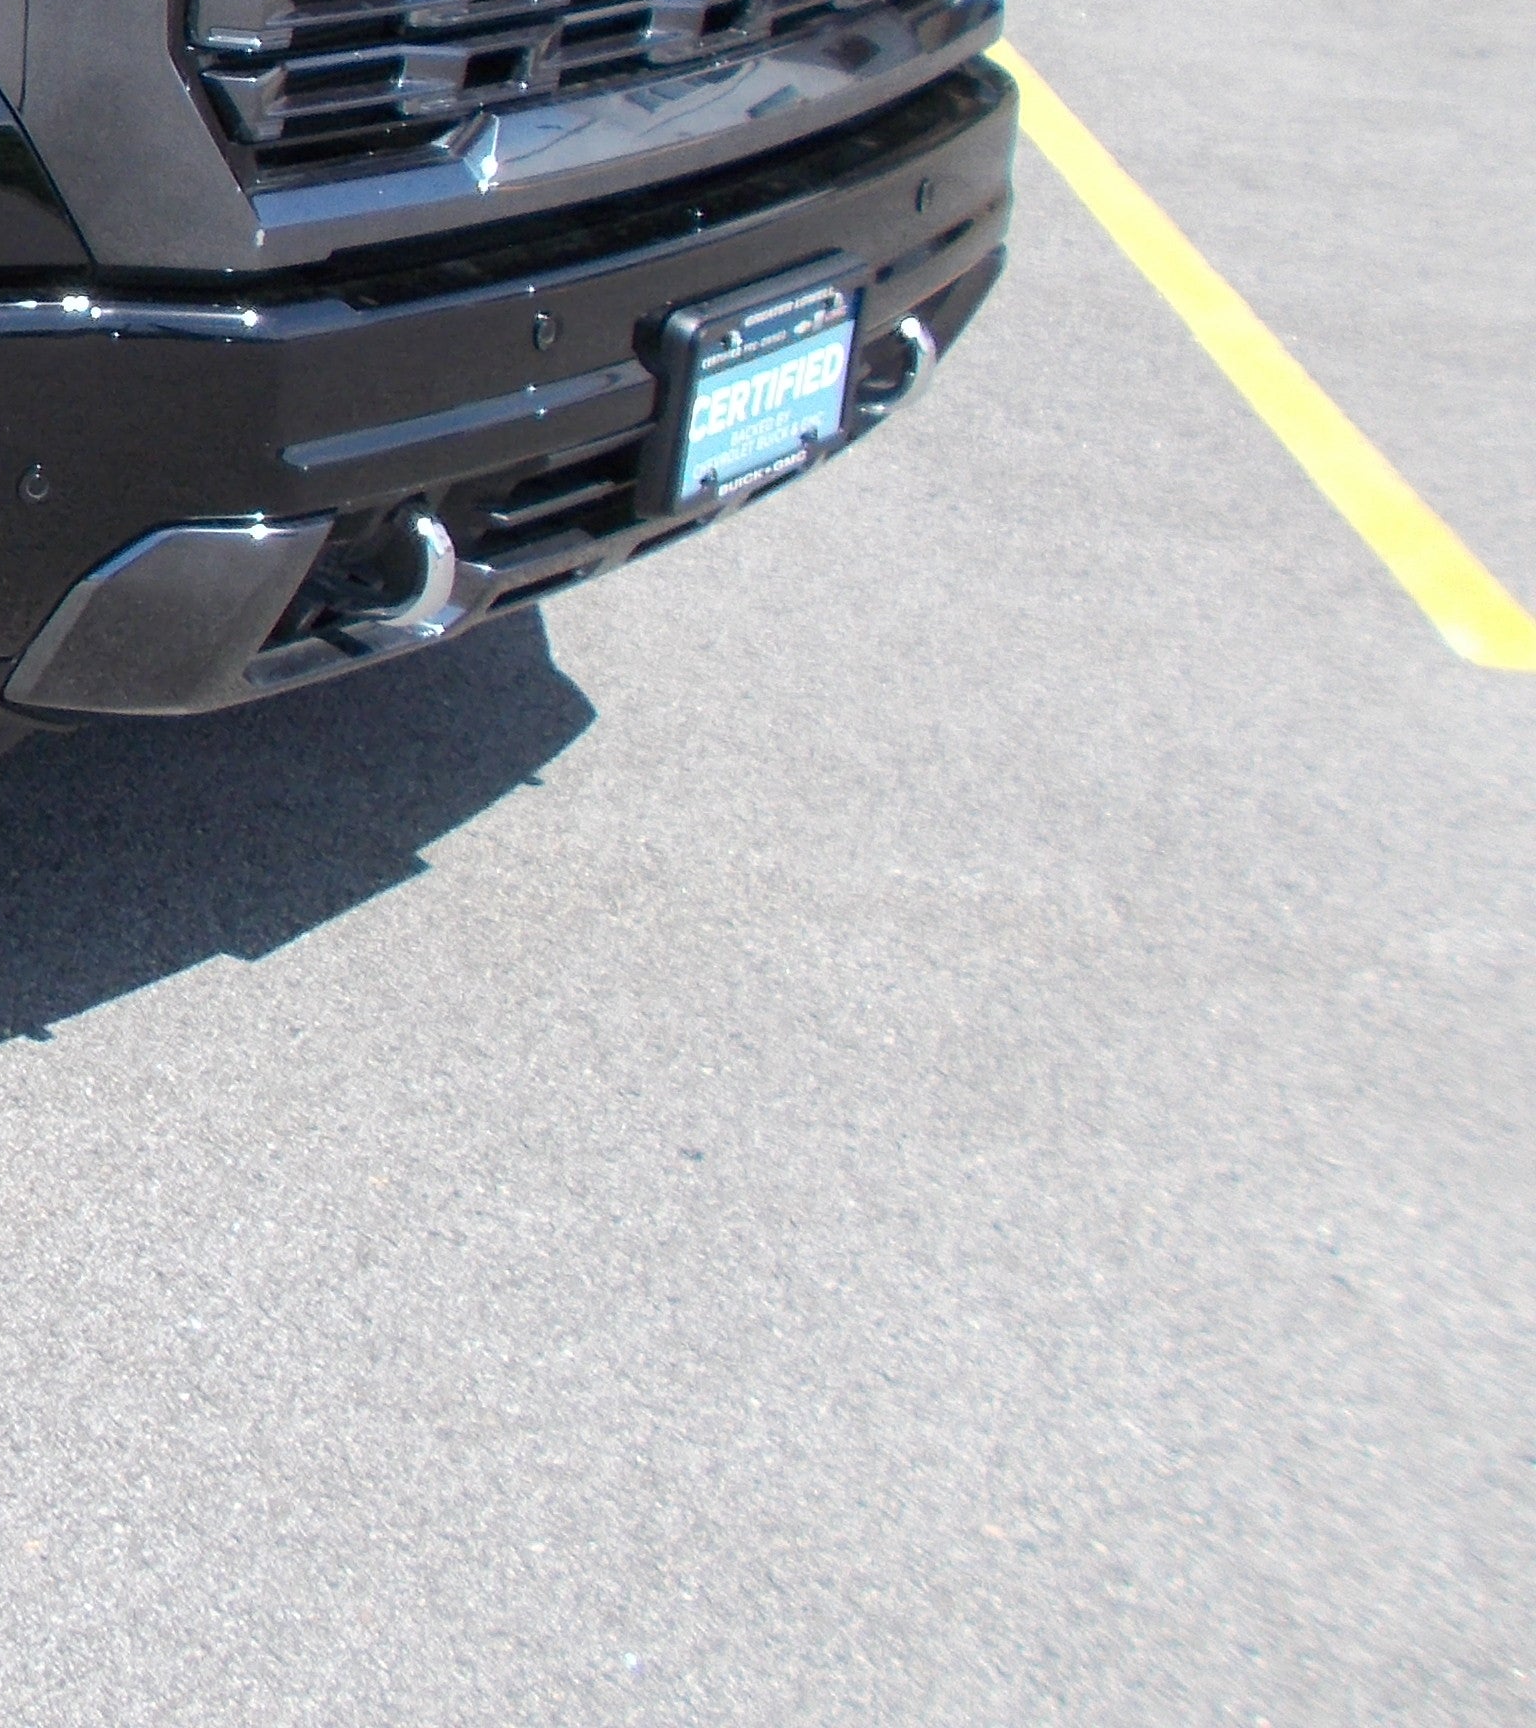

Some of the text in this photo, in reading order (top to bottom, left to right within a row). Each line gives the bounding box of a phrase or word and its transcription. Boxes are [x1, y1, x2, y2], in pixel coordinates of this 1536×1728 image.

[689, 342, 845, 443] CERTIFIED
[718, 449, 808, 497] BUICK GMC
